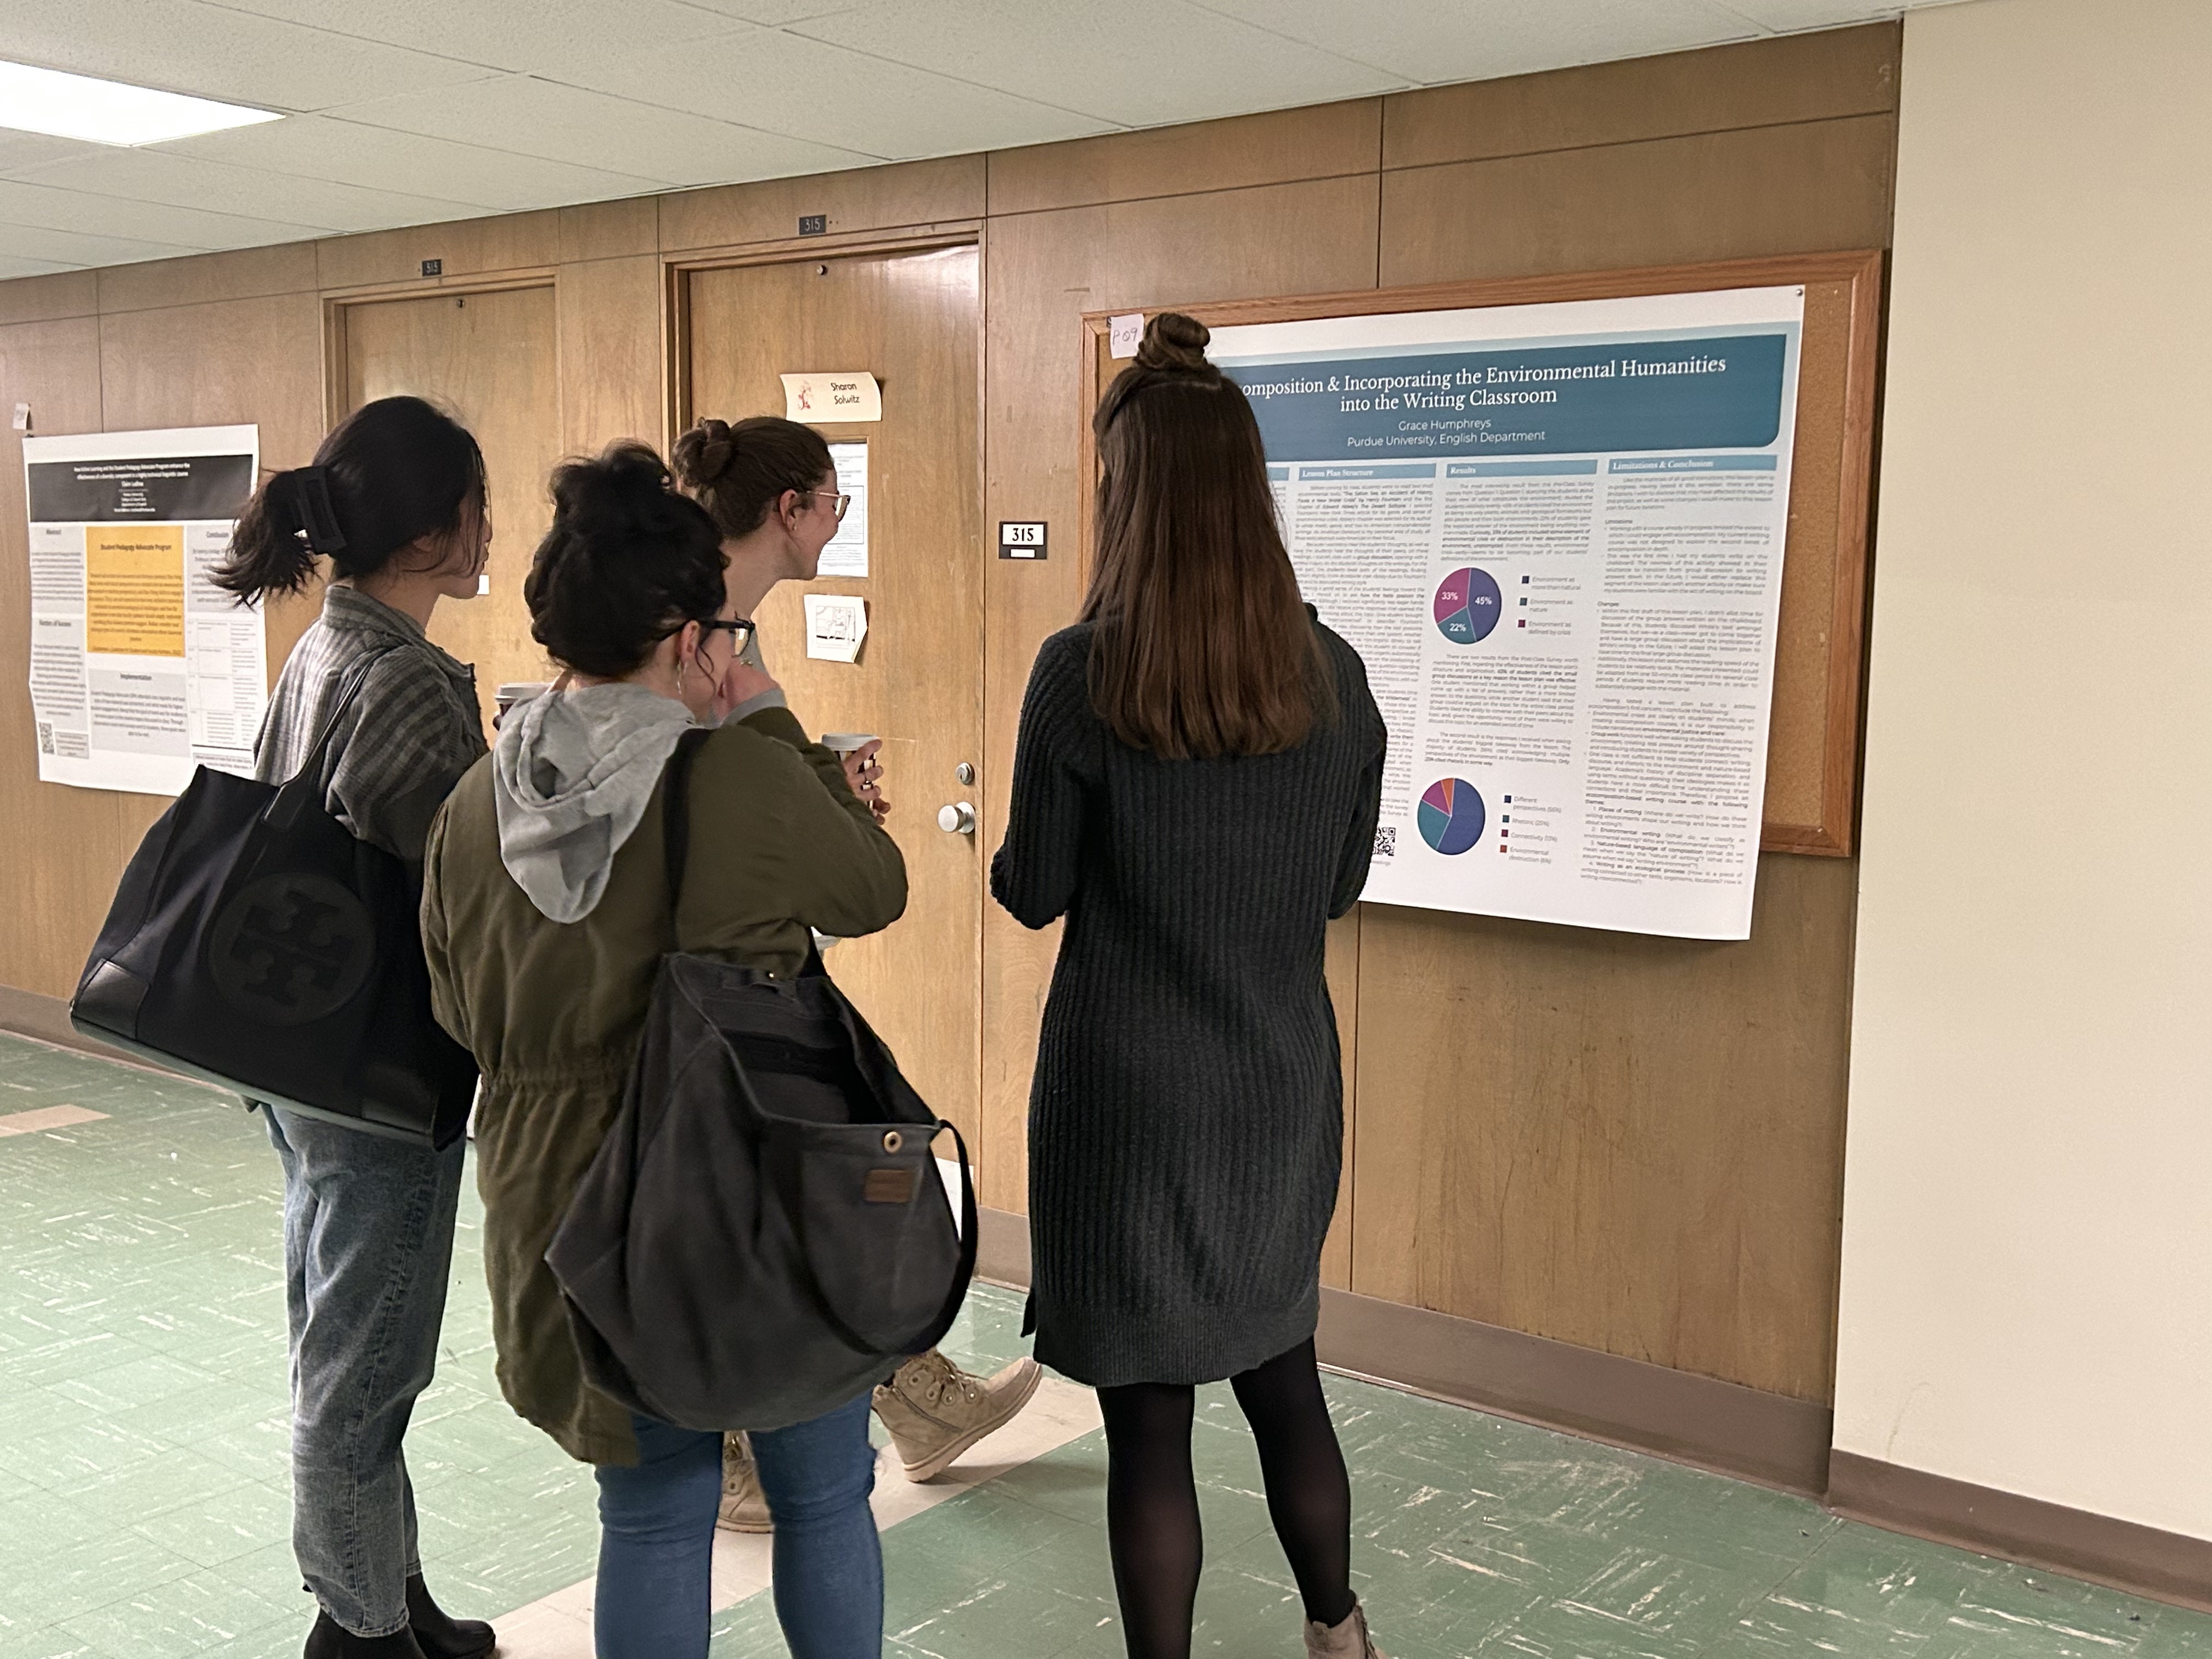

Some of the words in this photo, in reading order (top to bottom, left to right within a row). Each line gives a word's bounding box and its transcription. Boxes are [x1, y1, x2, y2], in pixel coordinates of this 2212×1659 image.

[805, 218, 820, 232] 315
[1239, 377, 1323, 399] omposition
[1328, 376, 1340, 392] &
[1344, 370, 1452, 393] Incorporating
[1456, 368, 1481, 384] the
[1487, 360, 1616, 383] Environmental
[1621, 355, 1726, 376] Humanities
[830, 382, 857, 392] Sharon
[834, 395, 860, 405] Solwitz
[1341, 396, 1370, 412] into
[1375, 394, 1399, 410] the
[1404, 390, 1465, 410] Writing
[1470, 388, 1557, 406] Classroom
[1398, 420, 1427, 431] Grace
[1431, 419, 1492, 431] Humphreys
[1347, 436, 1384, 447] Purdue
[1386, 435, 1437, 445] University,
[1440, 433, 1477, 445] English
[1480, 431, 1545, 443] Department
[1612, 461, 1658, 470] Limitations
[1659, 461, 1666, 469] &
[1668, 460, 1714, 469] Conclusion
[1451, 466, 1476, 475] Results
[1012, 527, 1034, 541] 315
[1441, 591, 1458, 601] 33%
[1475, 596, 1492, 605] 45%
[1449, 623, 1466, 632] 22%
